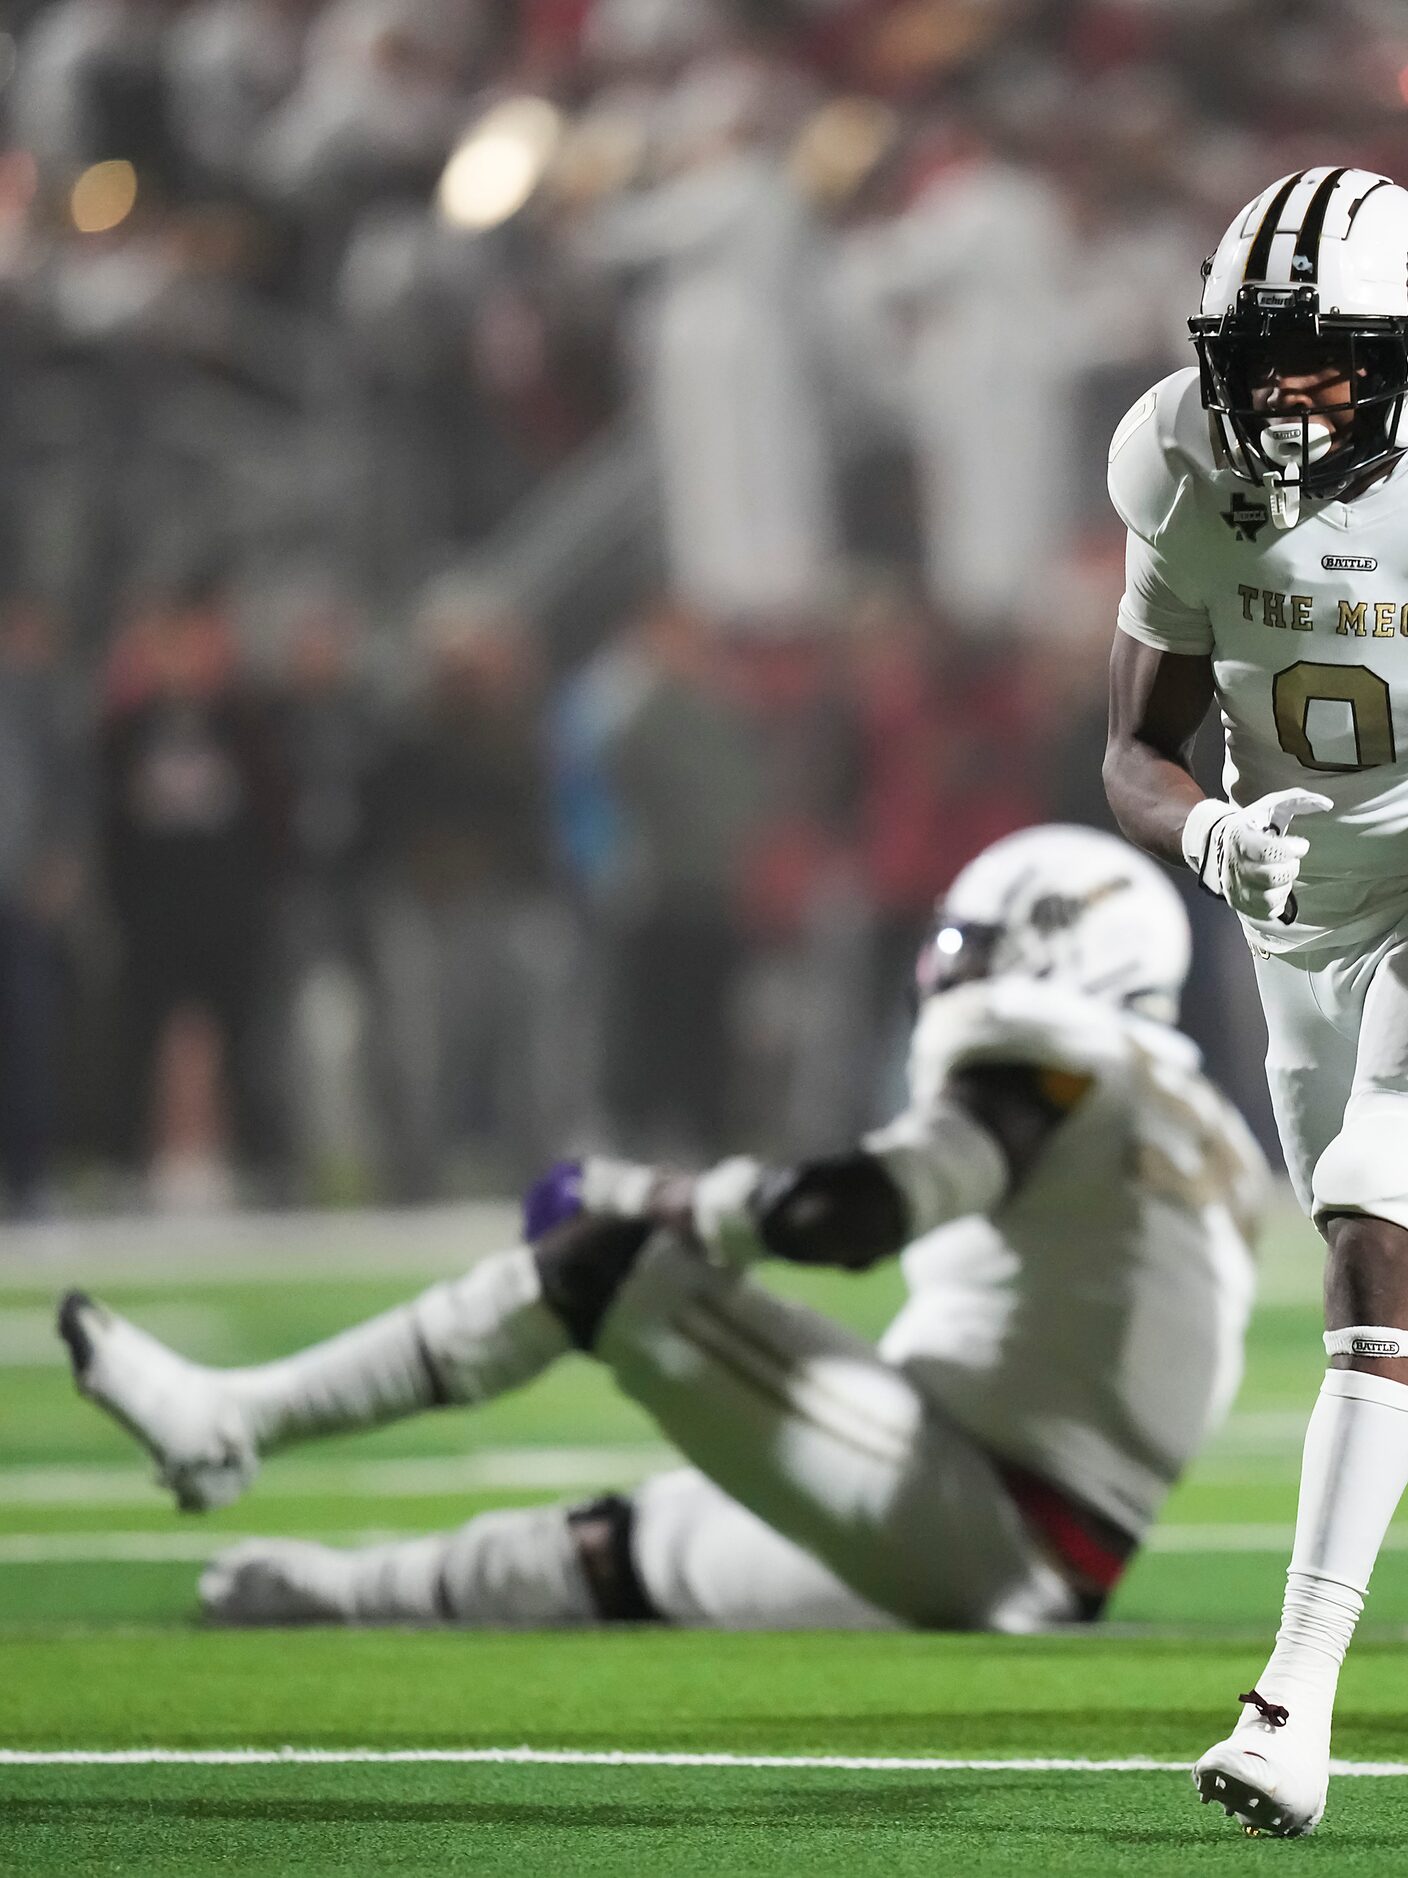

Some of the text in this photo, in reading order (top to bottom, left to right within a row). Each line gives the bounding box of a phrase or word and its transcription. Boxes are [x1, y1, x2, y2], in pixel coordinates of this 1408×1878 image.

[1325, 555, 1373, 570] BATTLE
[1238, 583, 1314, 632] THE
[1272, 660, 1397, 772] 0
[1355, 1341, 1397, 1353] BATTLE
